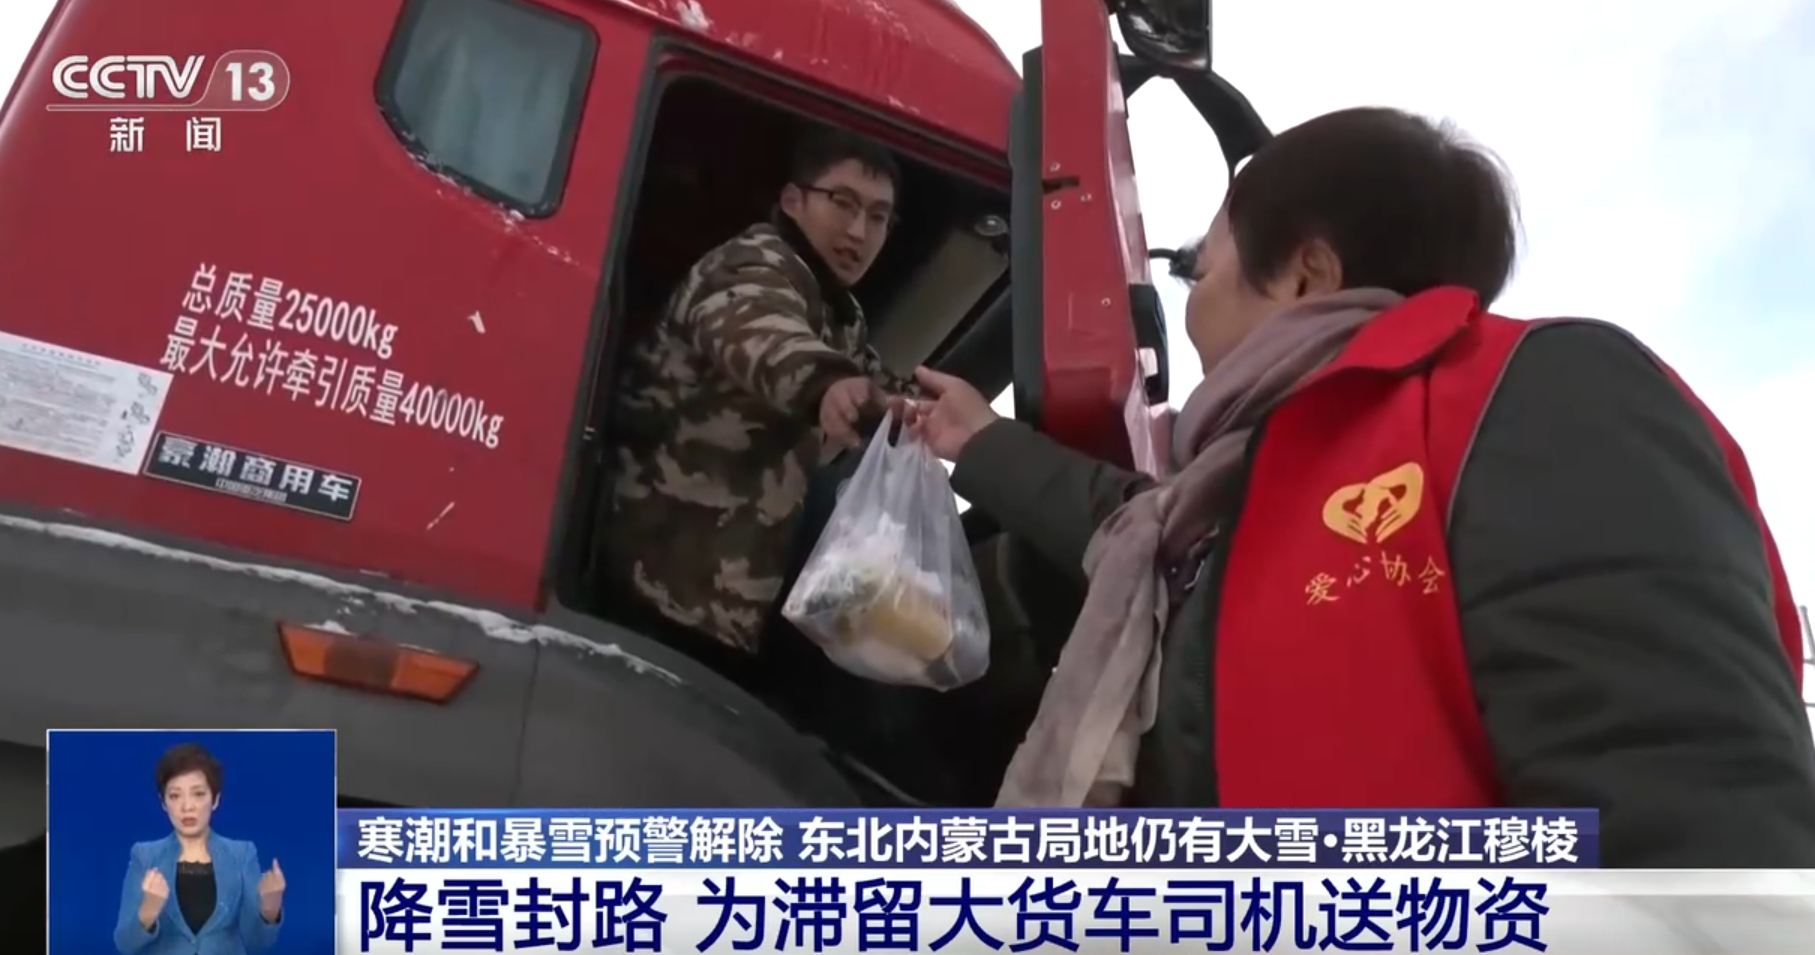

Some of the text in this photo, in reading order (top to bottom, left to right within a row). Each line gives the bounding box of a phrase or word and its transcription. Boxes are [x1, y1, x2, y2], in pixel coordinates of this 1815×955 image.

[182, 262, 398, 360] 总质量25000kg
[160, 315, 504, 449] 最大允许牵引质量40000kg
[158, 436, 353, 502] 豪瀚商用车
[1305, 551, 1445, 605] 爱心协会
